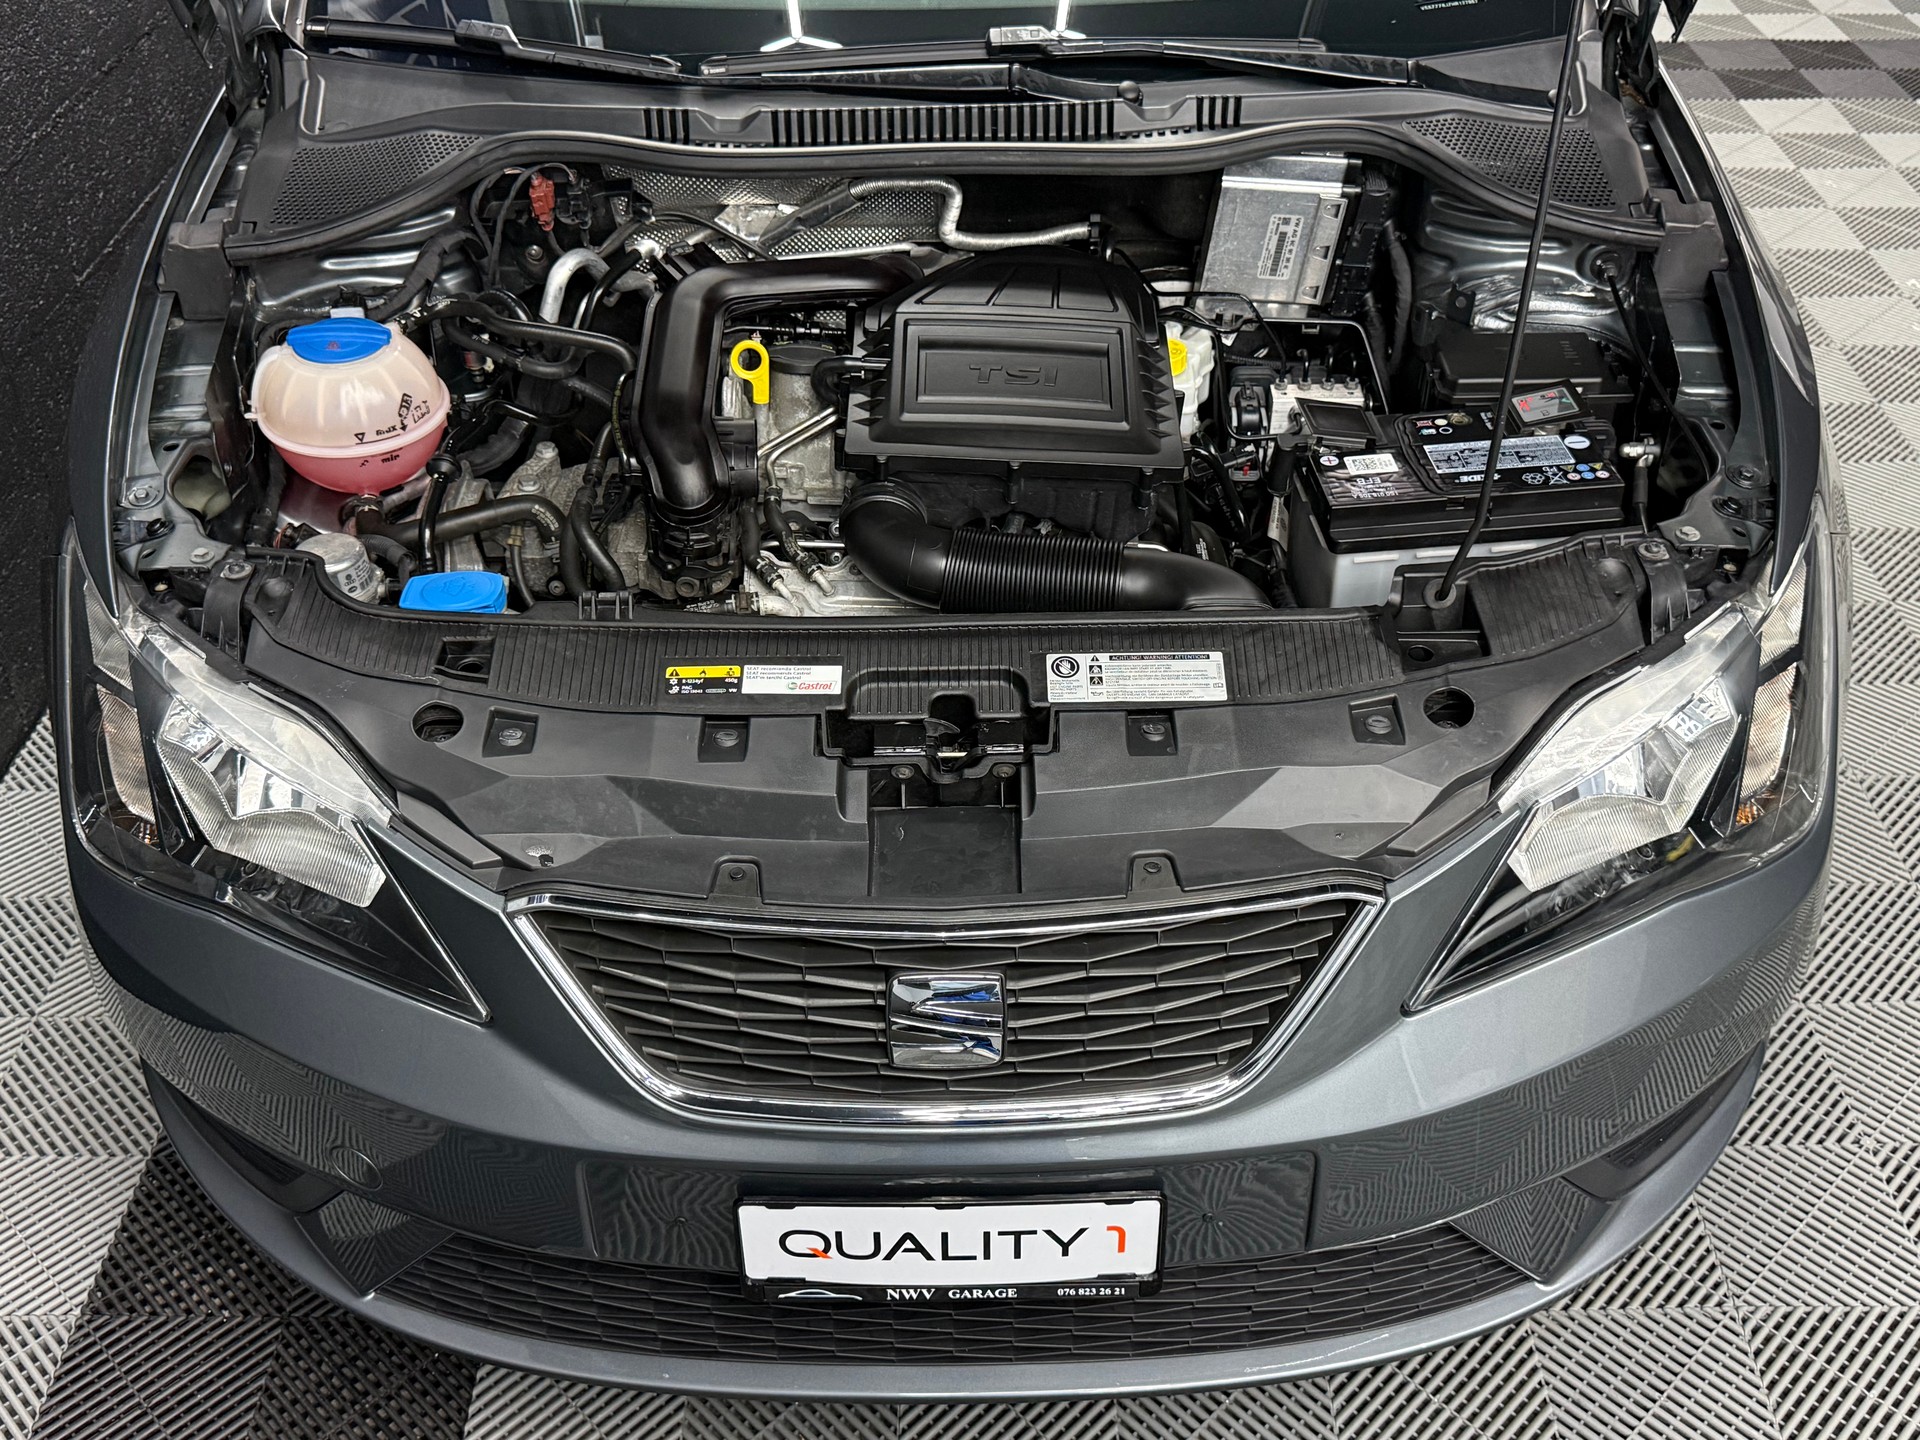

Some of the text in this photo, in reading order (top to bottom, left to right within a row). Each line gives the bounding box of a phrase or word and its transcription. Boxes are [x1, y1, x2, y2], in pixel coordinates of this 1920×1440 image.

[969, 364, 1058, 387] TSI
[1357, 476, 1382, 485] EFB
[798, 682, 833, 690] Castrol
[778, 1226, 1126, 1261] QUALITY 1
[886, 1286, 1126, 1301] NWV GARAGE 076 823 26 21
